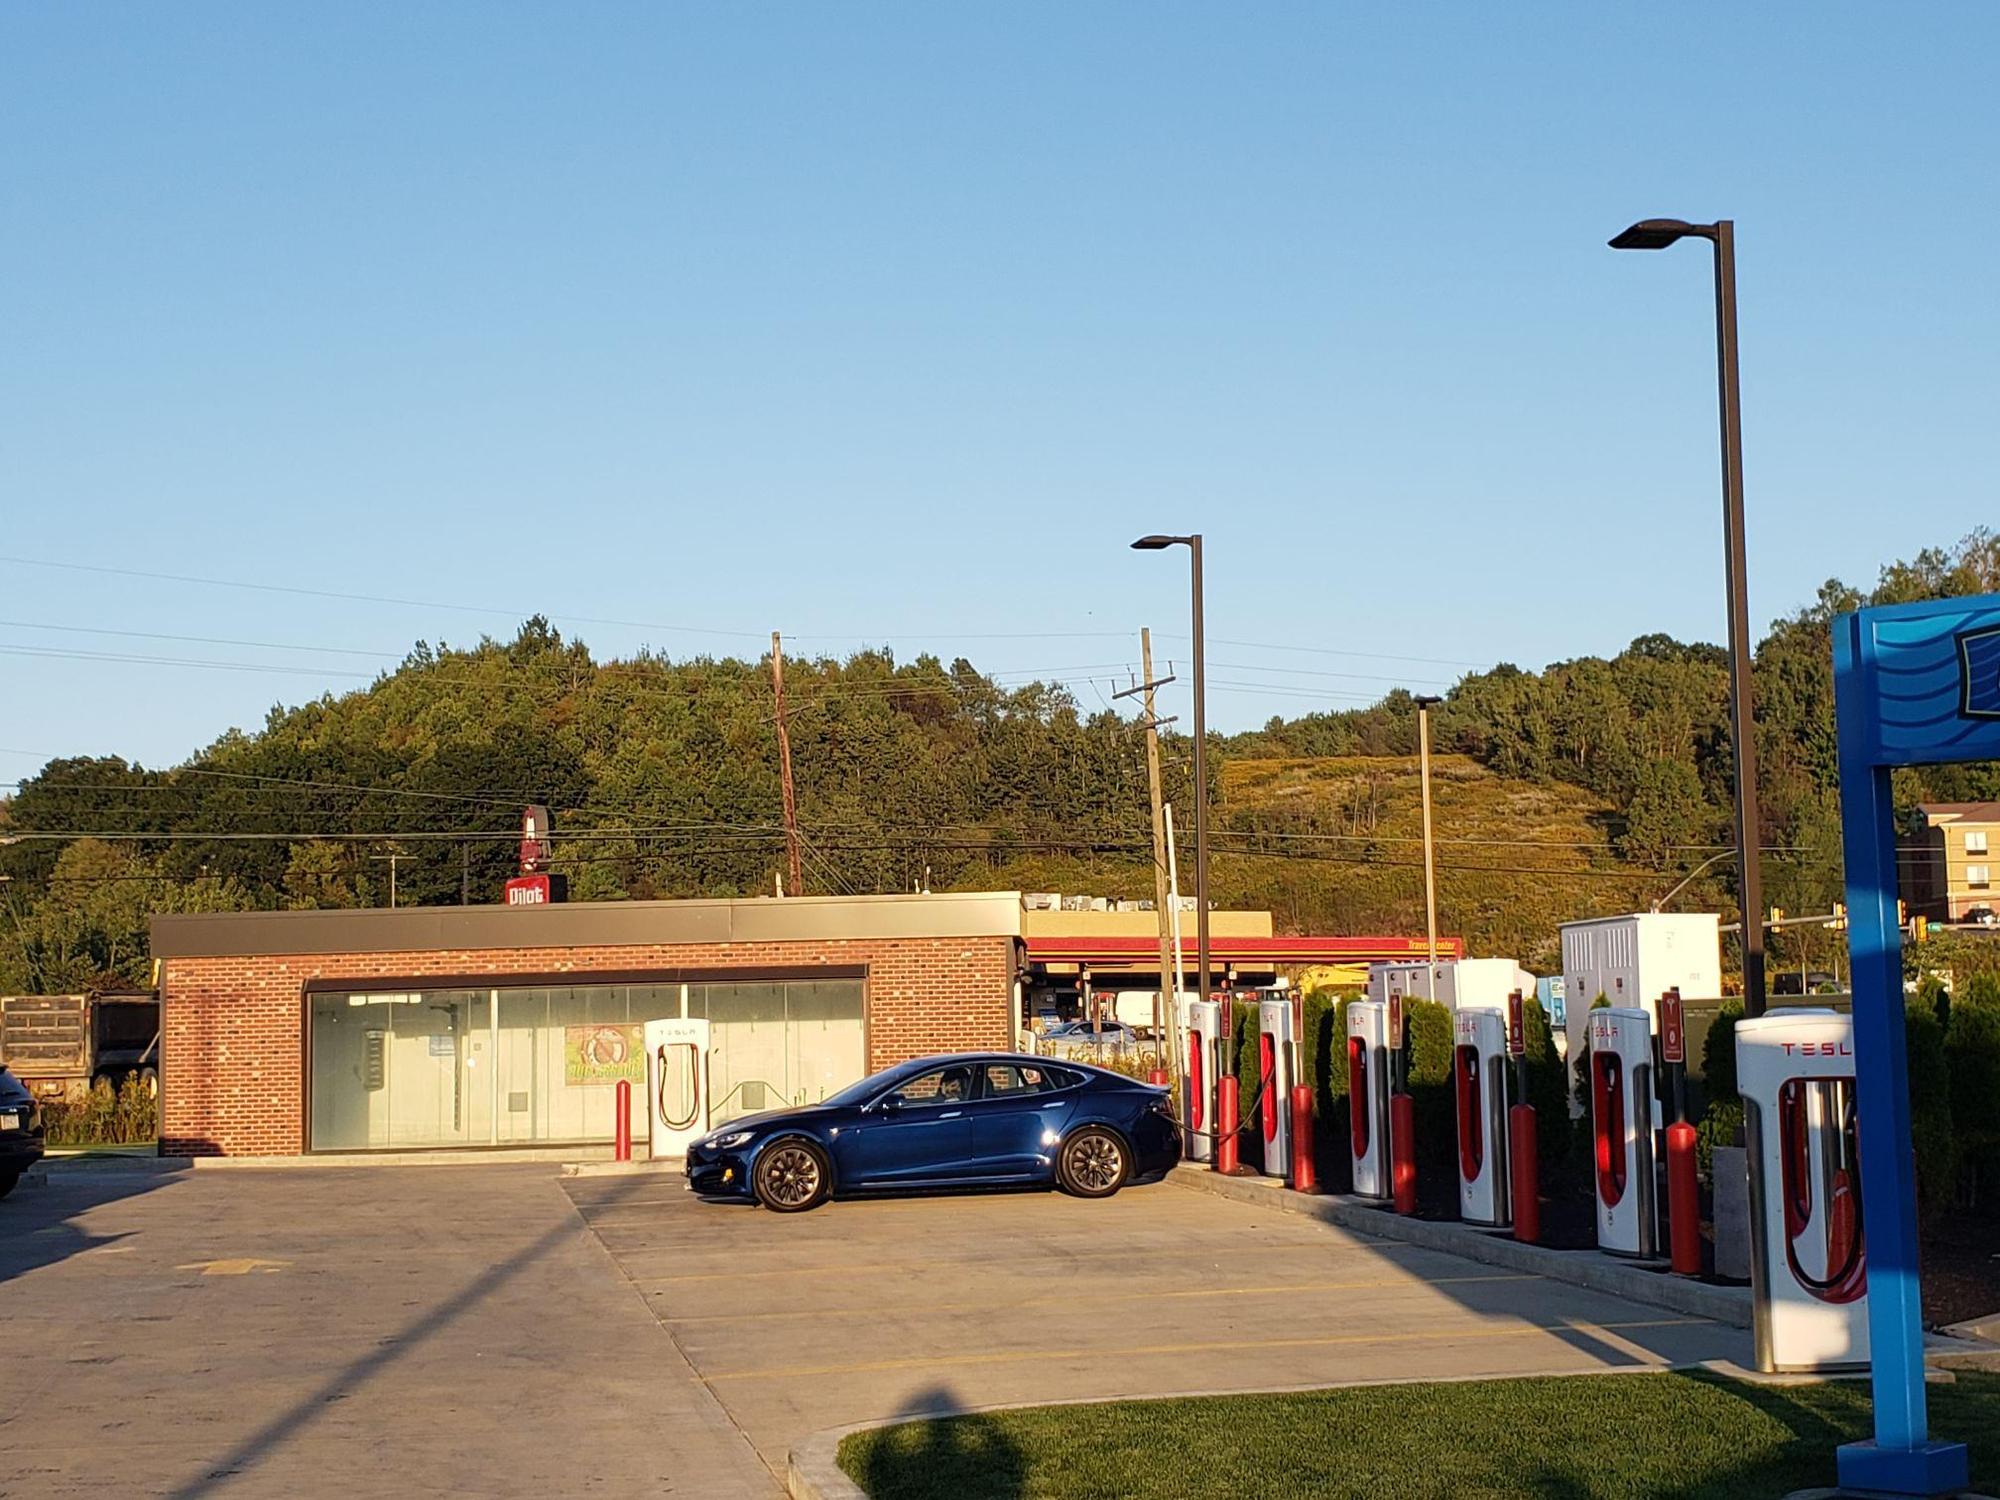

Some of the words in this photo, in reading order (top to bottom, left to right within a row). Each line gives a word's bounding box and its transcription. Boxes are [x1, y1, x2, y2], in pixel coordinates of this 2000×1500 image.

[509, 886, 544, 906] Pilot
[1408, 940, 1431, 950] Trave
[1434, 940, 1456, 950] enter
[659, 1028, 696, 1037] TESLA
[1781, 1042, 1852, 1056] TESL
